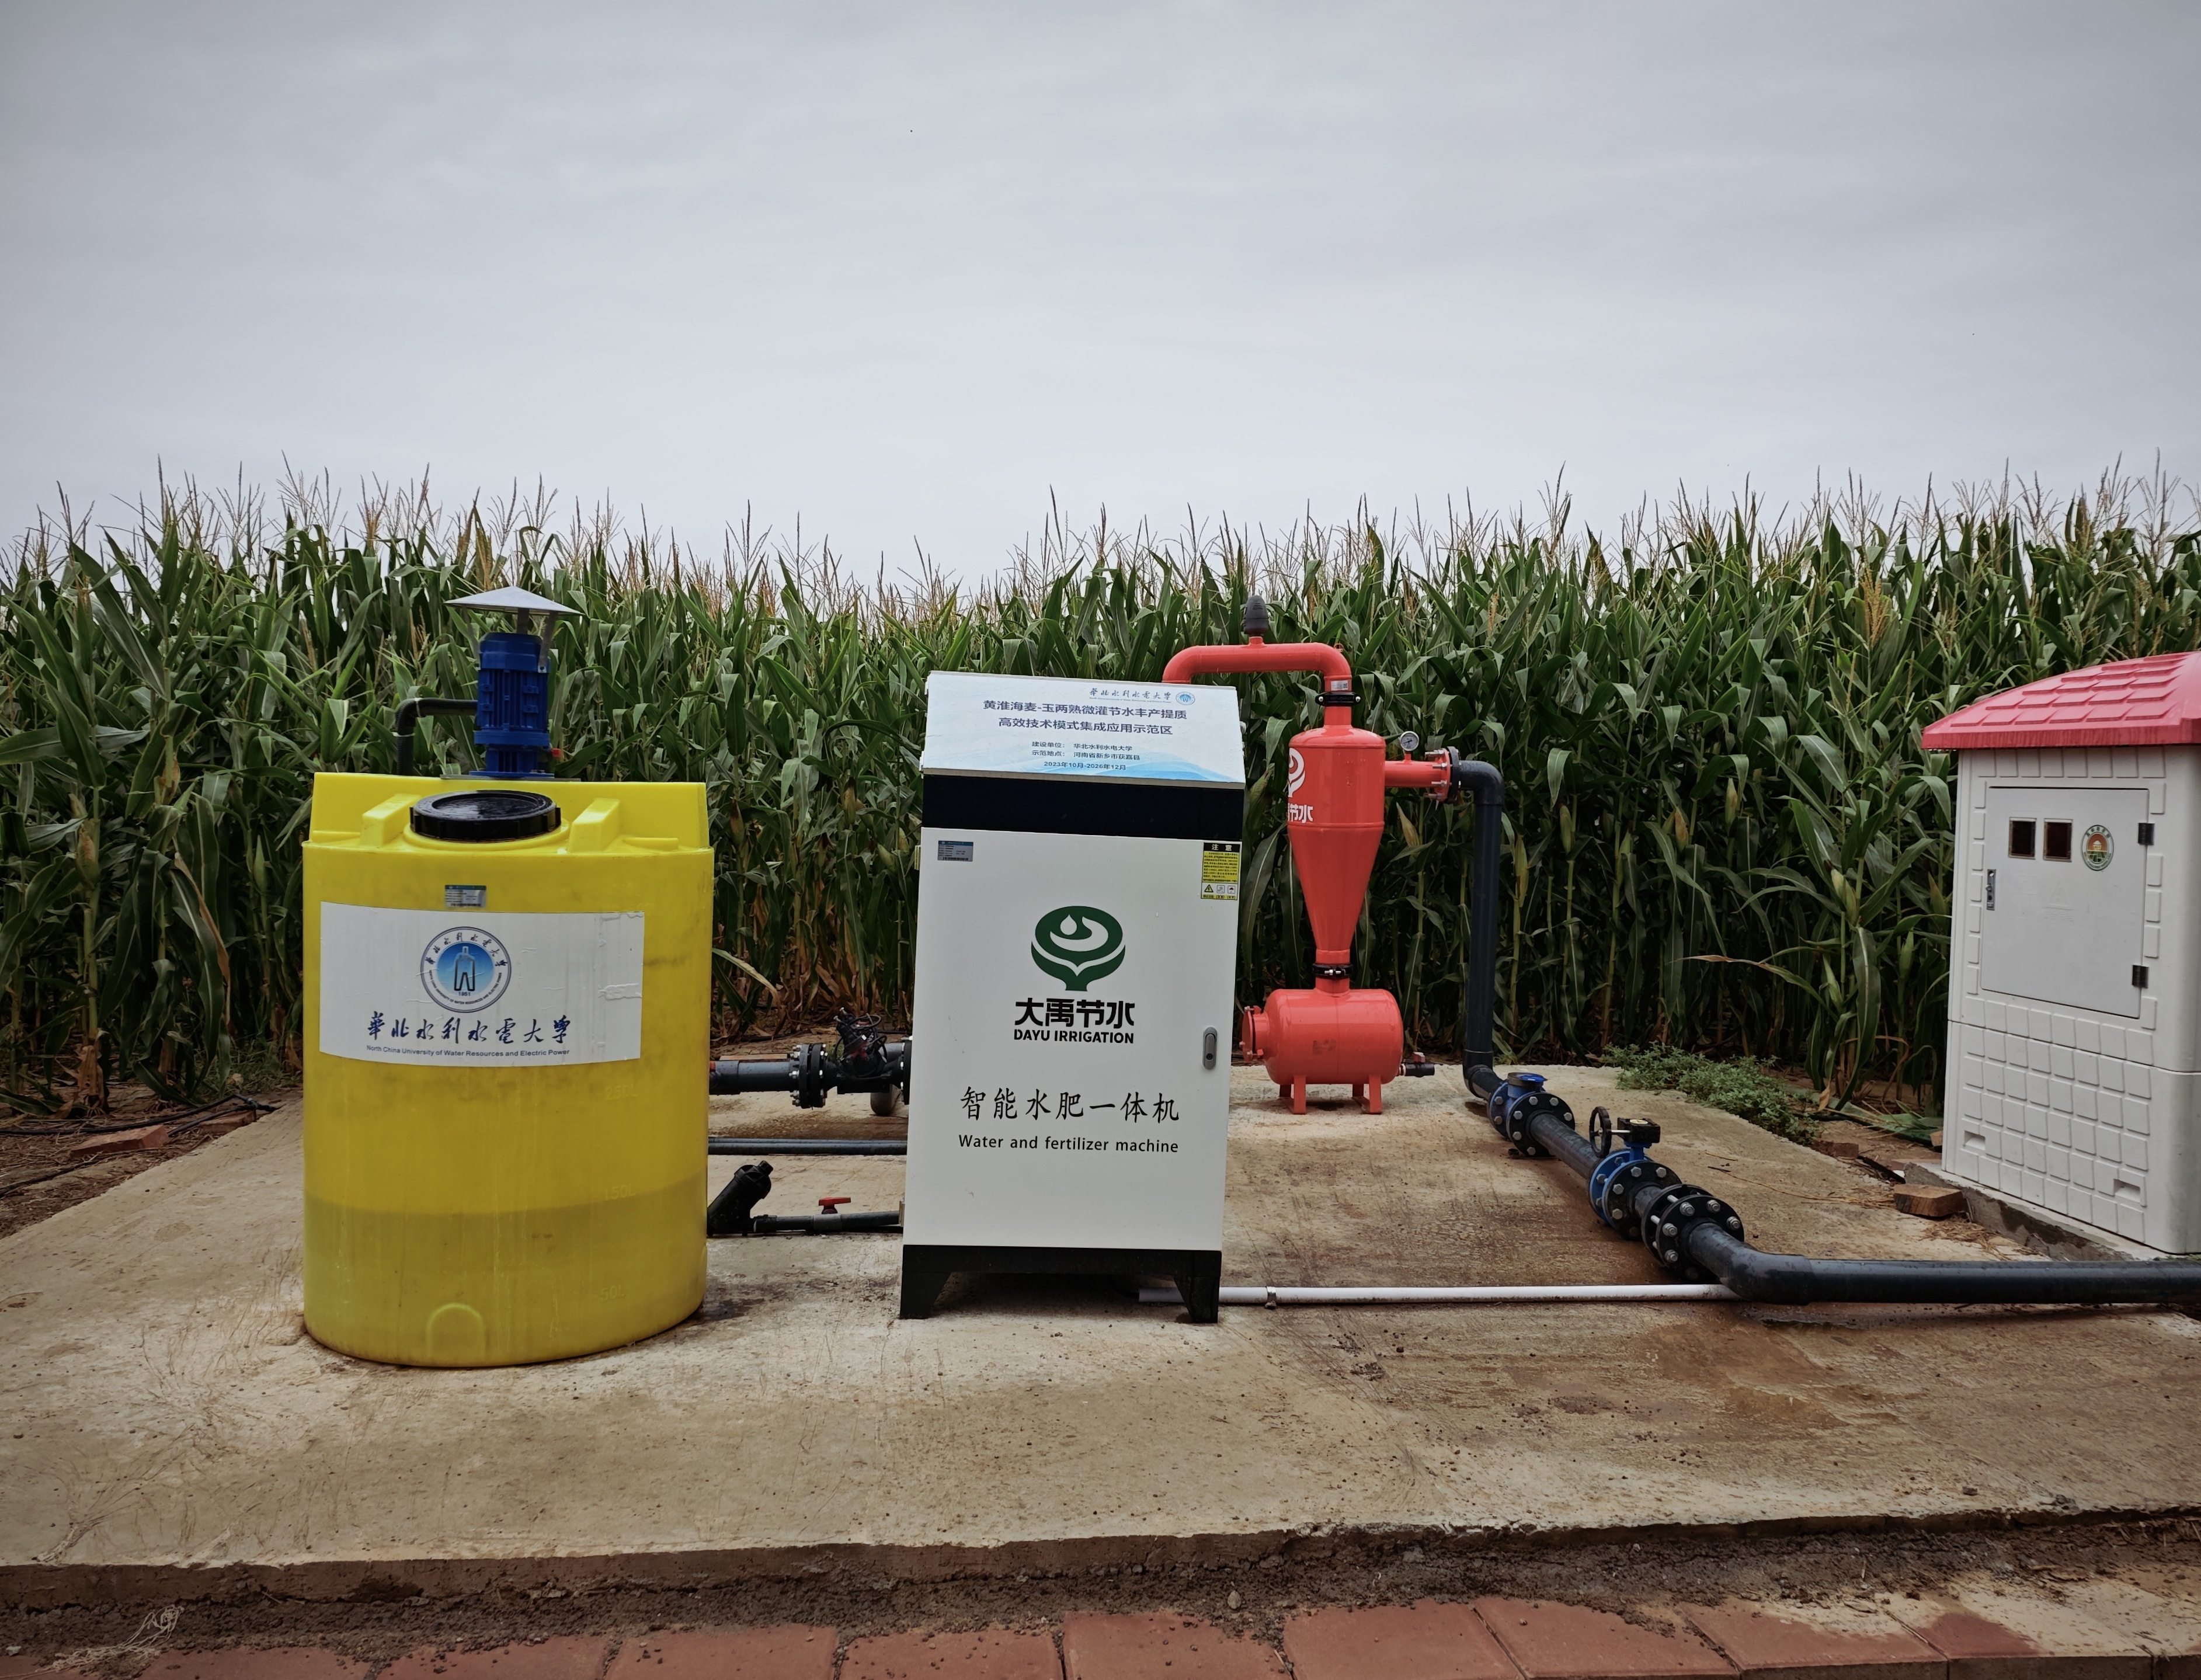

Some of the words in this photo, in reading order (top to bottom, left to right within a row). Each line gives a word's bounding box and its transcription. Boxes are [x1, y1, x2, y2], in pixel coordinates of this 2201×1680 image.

[983, 700, 1187, 719] 黄淮海麦-玉两熟微灌节水丰产提质
[999, 717, 1173, 735] 高效技术模式集成应用示范区
[1044, 761, 1126, 770] 2023年10月-2026年12月
[1288, 802, 1313, 823] 节水
[1014, 997, 1135, 1029] 大禹节水
[1014, 1029, 1050, 1041] DAYU
[1054, 1030, 1134, 1044] IRRIGATION
[402, 1048, 434, 1056] University
[960, 1086, 1179, 1124] 智能水肥一体机
[958, 1134, 1004, 1148] Water
[1010, 1136, 1038, 1149] and
[1045, 1136, 1109, 1151] fertilizer
[1115, 1139, 1178, 1153] machine
[603, 1183, 637, 1201] 150L
[600, 1284, 625, 1302] 50L
